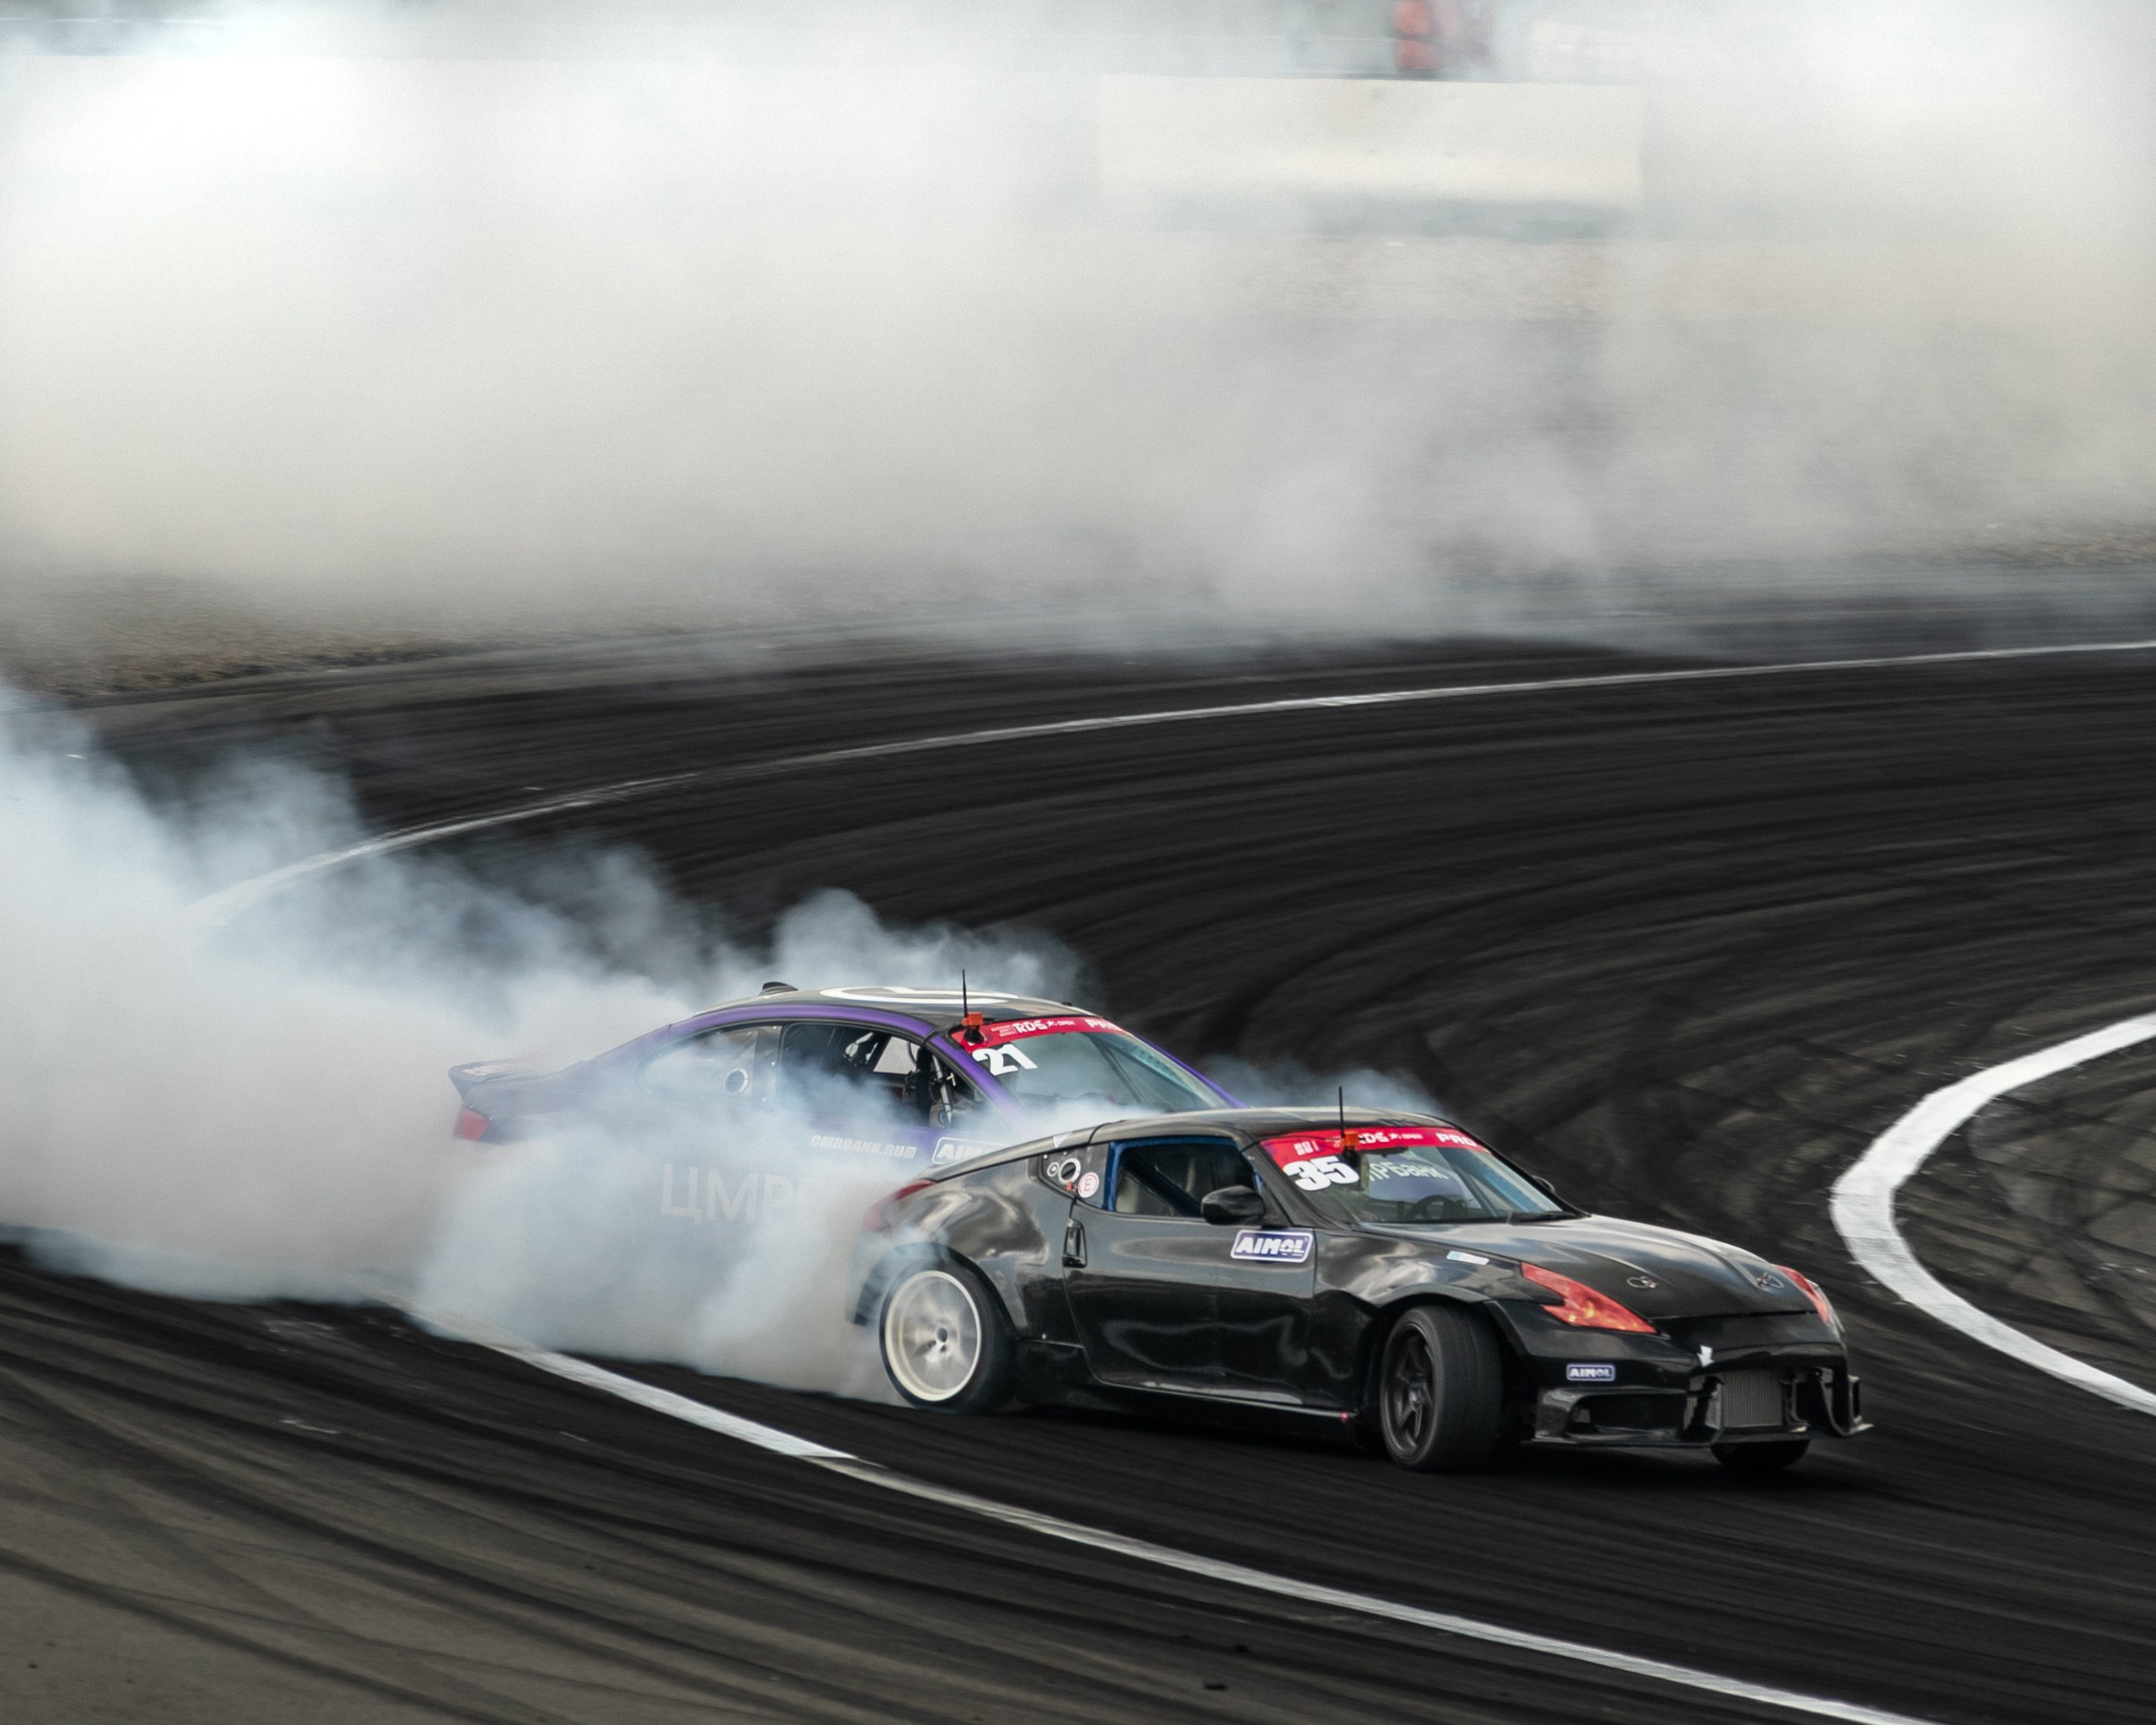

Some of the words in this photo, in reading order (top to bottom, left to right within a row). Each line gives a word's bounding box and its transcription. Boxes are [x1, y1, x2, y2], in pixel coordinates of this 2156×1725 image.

[1012, 1019, 1048, 1033] RDS
[972, 1044, 1038, 1076] 21
[1435, 1133, 1479, 1147] PRO
[937, 1144, 993, 1161] AIM
[1283, 1156, 1360, 1191] 35
[1235, 1237, 1305, 1255] AIMOL
